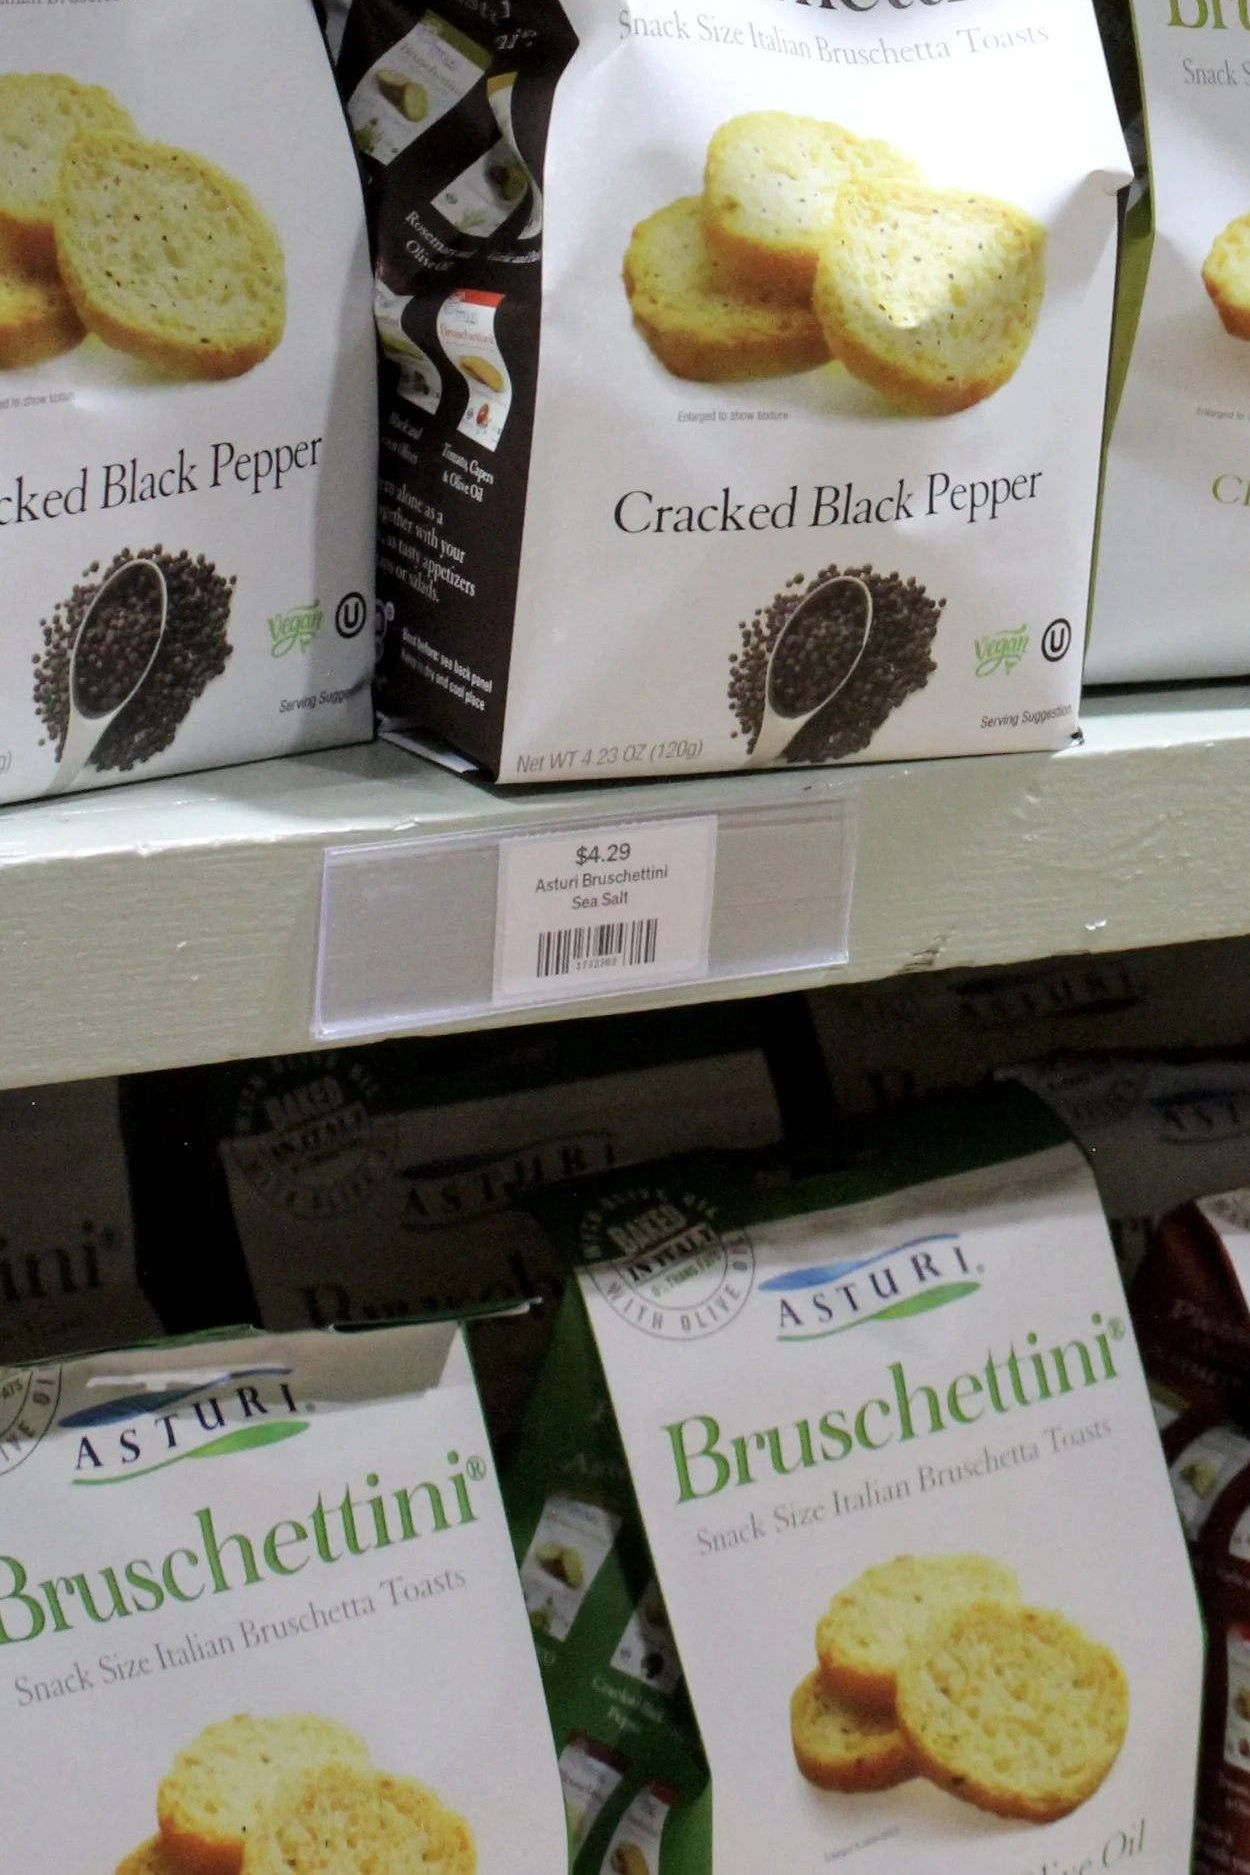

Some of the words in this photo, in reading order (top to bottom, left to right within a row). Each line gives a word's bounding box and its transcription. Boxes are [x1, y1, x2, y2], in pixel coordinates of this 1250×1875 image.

[618, 9, 690, 42] Snack
[697, 13, 746, 46] Size
[747, 20, 812, 60] Italian
[817, 36, 952, 65] Bruschetta
[956, 23, 1050, 55] Toasts
[1183, 58, 1238, 87] Snack
[729, 410, 755, 421] show
[99, 448, 200, 510] Black
[210, 436, 323, 494] Pepper
[449, 472, 471, 496] Olive
[470, 484, 484, 503] Oil
[469, 458, 495, 486] Capers
[613, 486, 796, 534] Cracked
[808, 478, 914, 528] Black
[925, 471, 1043, 526] Pepper
[415, 525, 438, 552] with
[440, 540, 467, 565] your
[422, 553, 476, 598] appetizers
[973, 624, 1030, 678] Vegan
[465, 687, 486, 712] place
[471, 668, 493, 694] panel
[279, 688, 316, 714] Serving
[980, 712, 1018, 730] Serving
[1021, 702, 1072, 725] Suggestion
[517, 752, 546, 775] Net
[548, 750, 578, 770] WT
[580, 746, 619, 768] 4.23
[622, 743, 647, 763] OZ
[649, 738, 703, 764] (120g)
[575, 842, 631, 866] $4.29
[535, 873, 579, 894] Asturi
[581, 865, 668, 889] Bruschettini
[571, 894, 598, 910] Sea
[601, 890, 629, 907] Salt
[778, 1245, 972, 1328] ASTURI
[606, 1281, 664, 1331] WITH
[679, 1283, 740, 1332] OLIVE
[696, 1513, 767, 1557] Snack
[773, 1493, 826, 1531] Size
[832, 1479, 911, 1518] Italian
[918, 1441, 1040, 1495] Bruschetta
[1043, 1419, 1113, 1456] Toasts
[14, 1661, 94, 1706] Snack
[99, 1646, 152, 1683] Size
[155, 1629, 236, 1672] Italian
[239, 1591, 376, 1648] Bruschetta
[379, 1567, 466, 1608] Toasts
[1101, 1818, 1146, 1869] Oil
